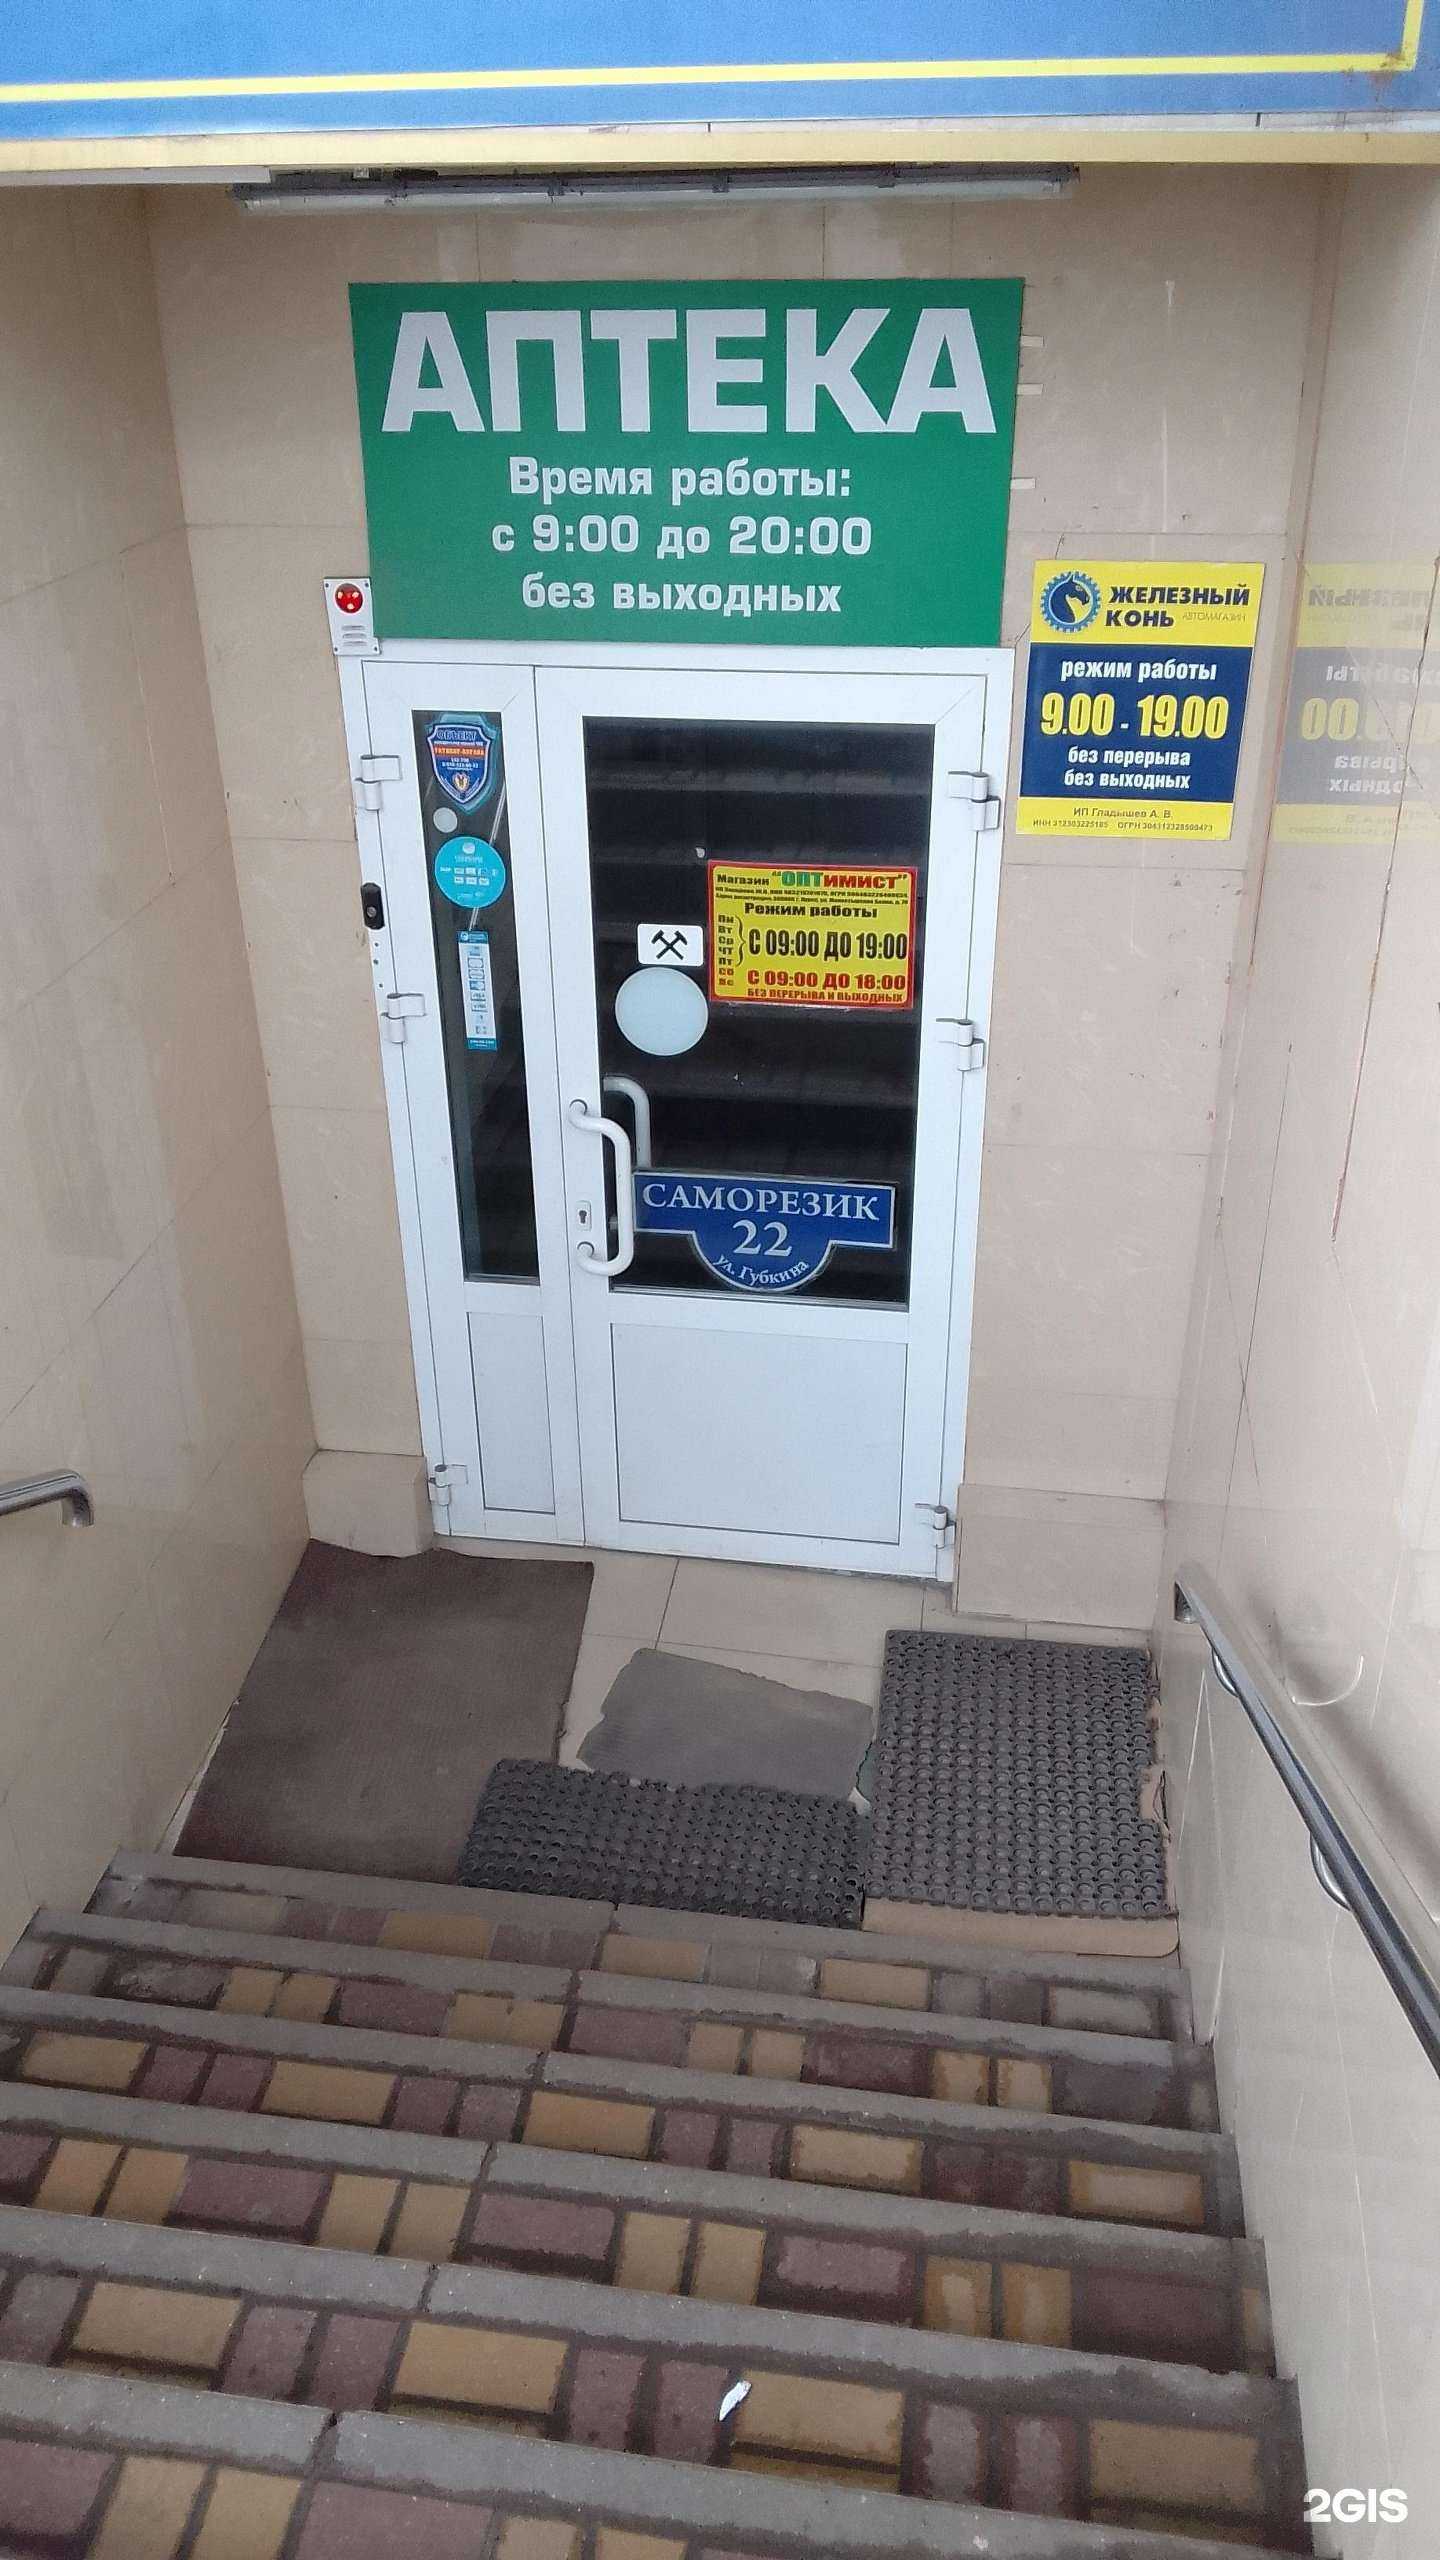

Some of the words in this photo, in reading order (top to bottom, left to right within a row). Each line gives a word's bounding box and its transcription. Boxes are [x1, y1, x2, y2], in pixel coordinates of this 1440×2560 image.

[381, 308, 996, 434] АПТЕКА
[508, 456, 652, 505] Время
[671, 458, 852, 505] работы:
[491, 524, 515, 552] с
[532, 515, 639, 552] 9:00
[656, 525, 712, 559] до
[728, 516, 872, 555] 20:00
[521, 571, 595, 609] без
[611, 583, 842, 617] выходных
[1110, 584, 1250, 606] ЖЕЛЕЗНЫЙ
[1105, 610, 1174, 627] КОНЬ
[1182, 612, 1247, 623] АВТОМАГАЗИН
[1060, 658, 1133, 682] режим
[1138, 659, 1216, 683] работы
[1040, 692, 1115, 737] 9.00
[1136, 694, 1229, 740] 19.00
[1068, 747, 1098, 764] без
[1103, 751, 1191, 769] перерыва
[1064, 769, 1094, 787] без
[1098, 774, 1190, 790] выходных
[1073, 808, 1089, 817] ИП
[717, 874, 769, 886] Магазин
[744, 902, 805, 916] Режим
[810, 906, 877, 918] работы
[749, 929, 761, 955] С
[766, 929, 820, 957] 09:00
[823, 932, 852, 962] ДО
[856, 933, 907, 960] 19:00
[747, 970, 759, 985] С
[764, 971, 818, 987] 09:00
[822, 973, 850, 990] ДО
[855, 974, 906, 990] 18:00
[747, 989, 767, 997] БЕЗ
[769, 990, 826, 999] ПЕРЕРЫВА
[837, 992, 903, 1002] ВЫХОДНЫХ
[642, 1183, 880, 1221] САМОРЕЗИК
[732, 1219, 793, 1257] 22
[712, 1254, 736, 1275] ул.
[739, 1260, 809, 1287] Губкина
